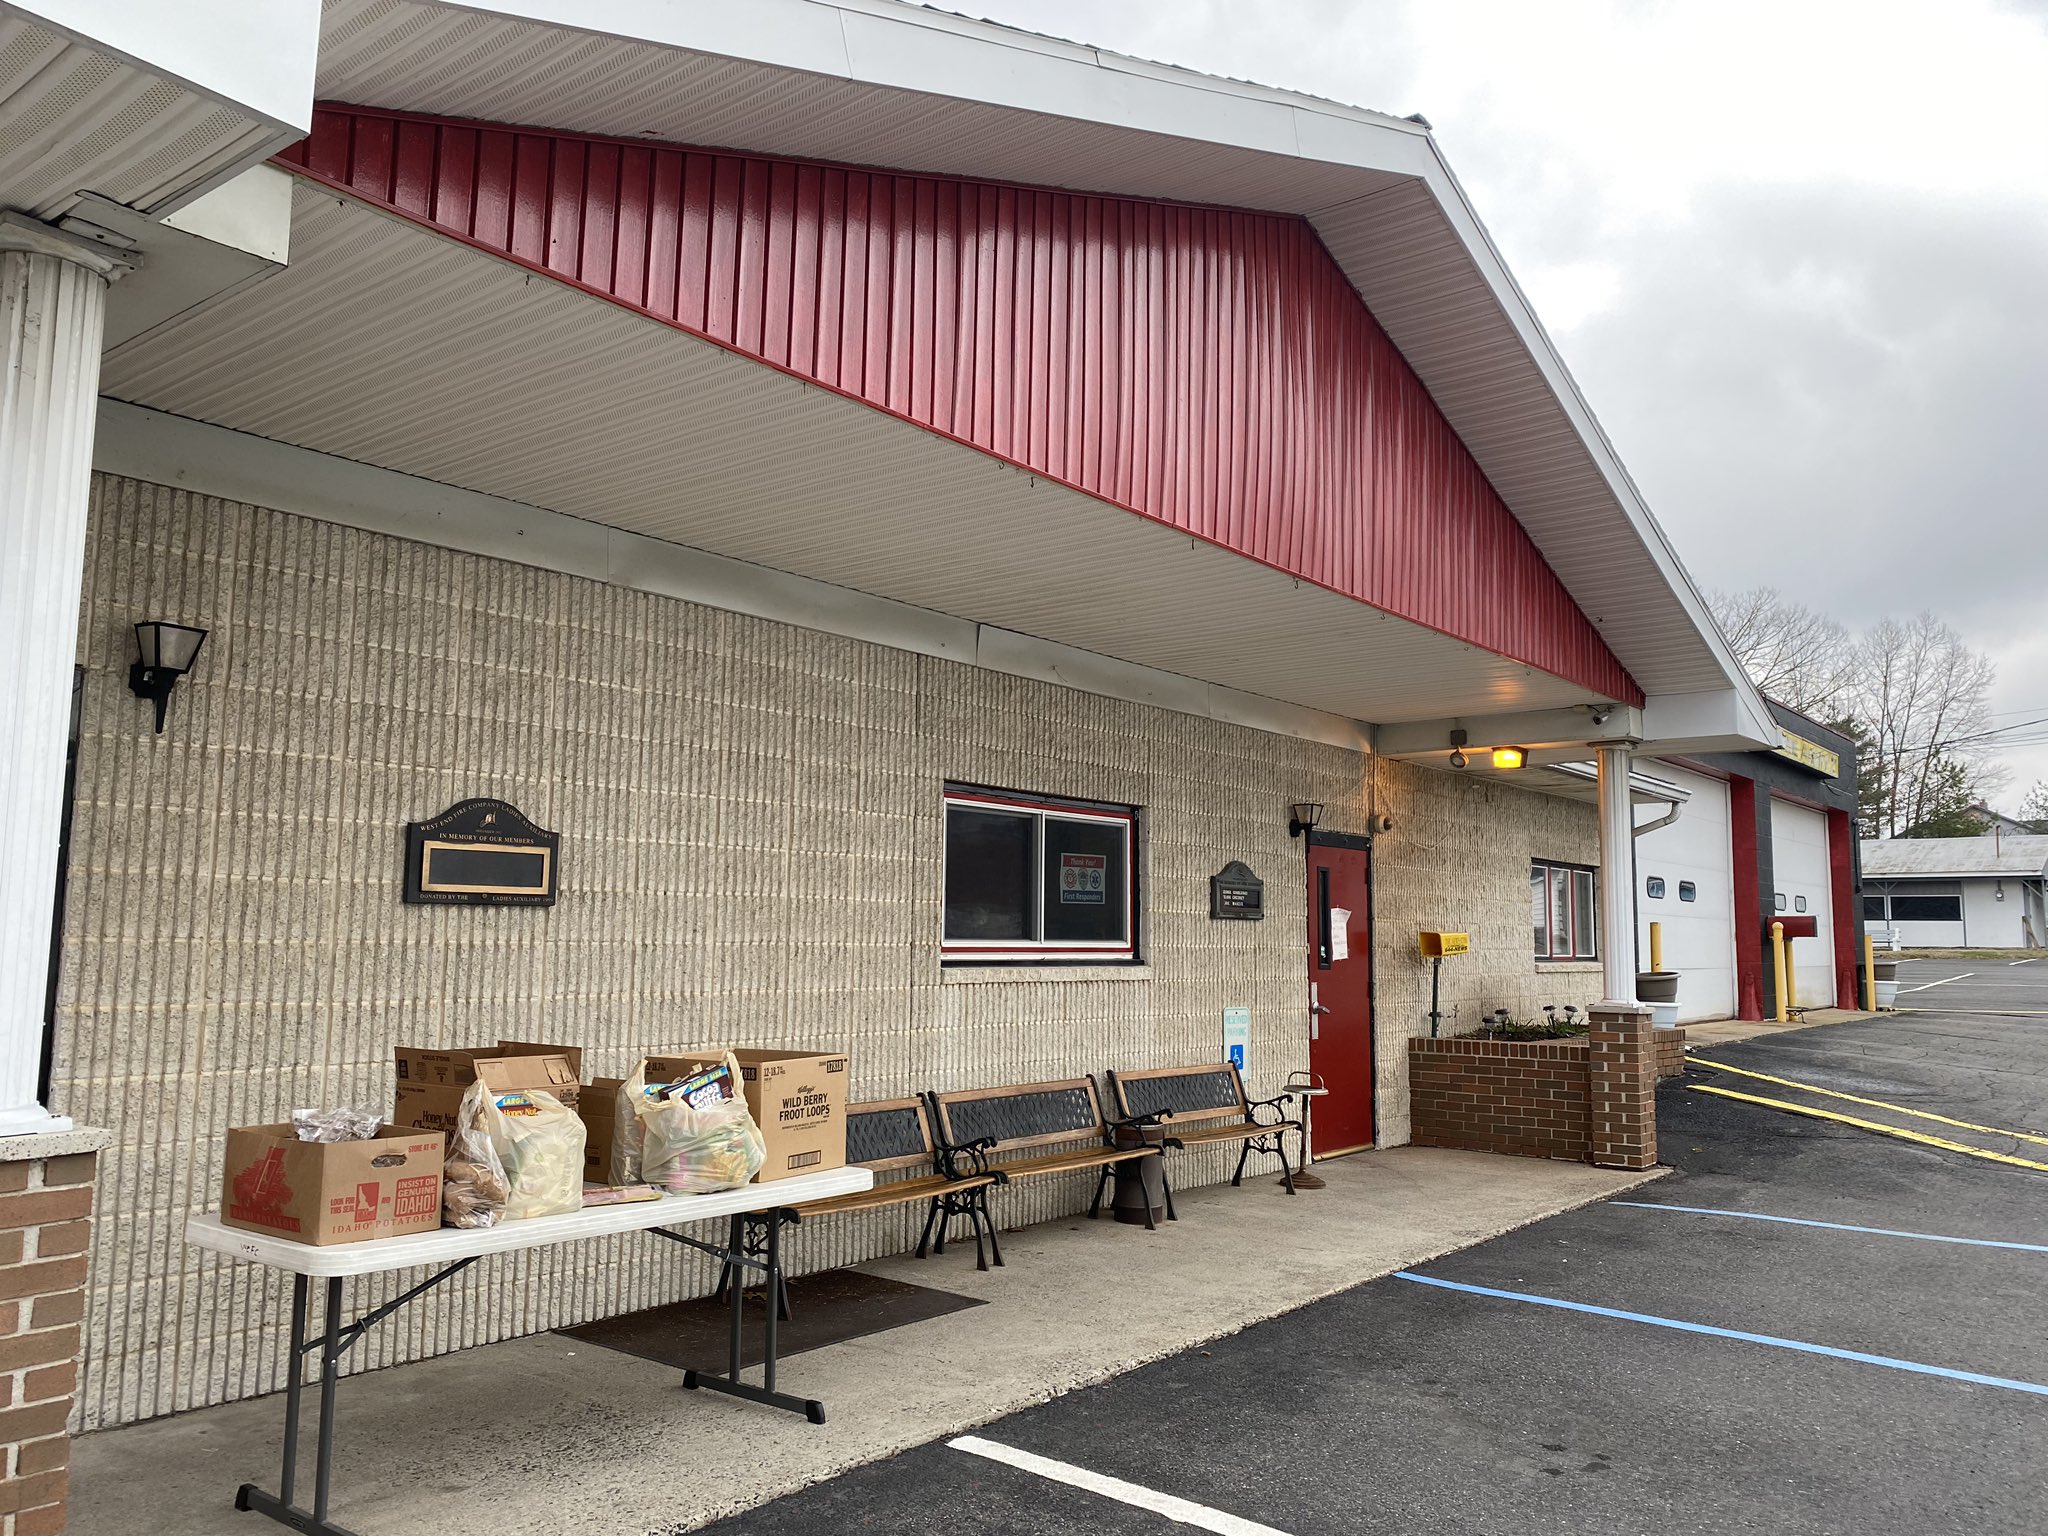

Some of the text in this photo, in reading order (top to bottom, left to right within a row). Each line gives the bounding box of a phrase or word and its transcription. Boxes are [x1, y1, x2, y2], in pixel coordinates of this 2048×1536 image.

[420, 802, 552, 839] WEST END FIRE COMPANY LADIES AUXILIARY
[1225, 1015, 1248, 1024] RESERVED
[1227, 1027, 1246, 1036] PARKING
[689, 1082, 720, 1106] Cocoa
[782, 1093, 828, 1109] WILD BERRY
[780, 1108, 804, 1121] FROOT
[807, 1104, 830, 1118] LOOPS
[422, 1110, 456, 1128] Honey Nut
[408, 1144, 423, 1152] STORE
[398, 1180, 424, 1189] INSIST
[398, 1186, 436, 1197] GENUINE
[331, 1198, 344, 1206] LOOK
[396, 1195, 435, 1215] IDAHO!
[343, 1205, 355, 1213] SEAL
[376, 1214, 433, 1228] POTATOES
